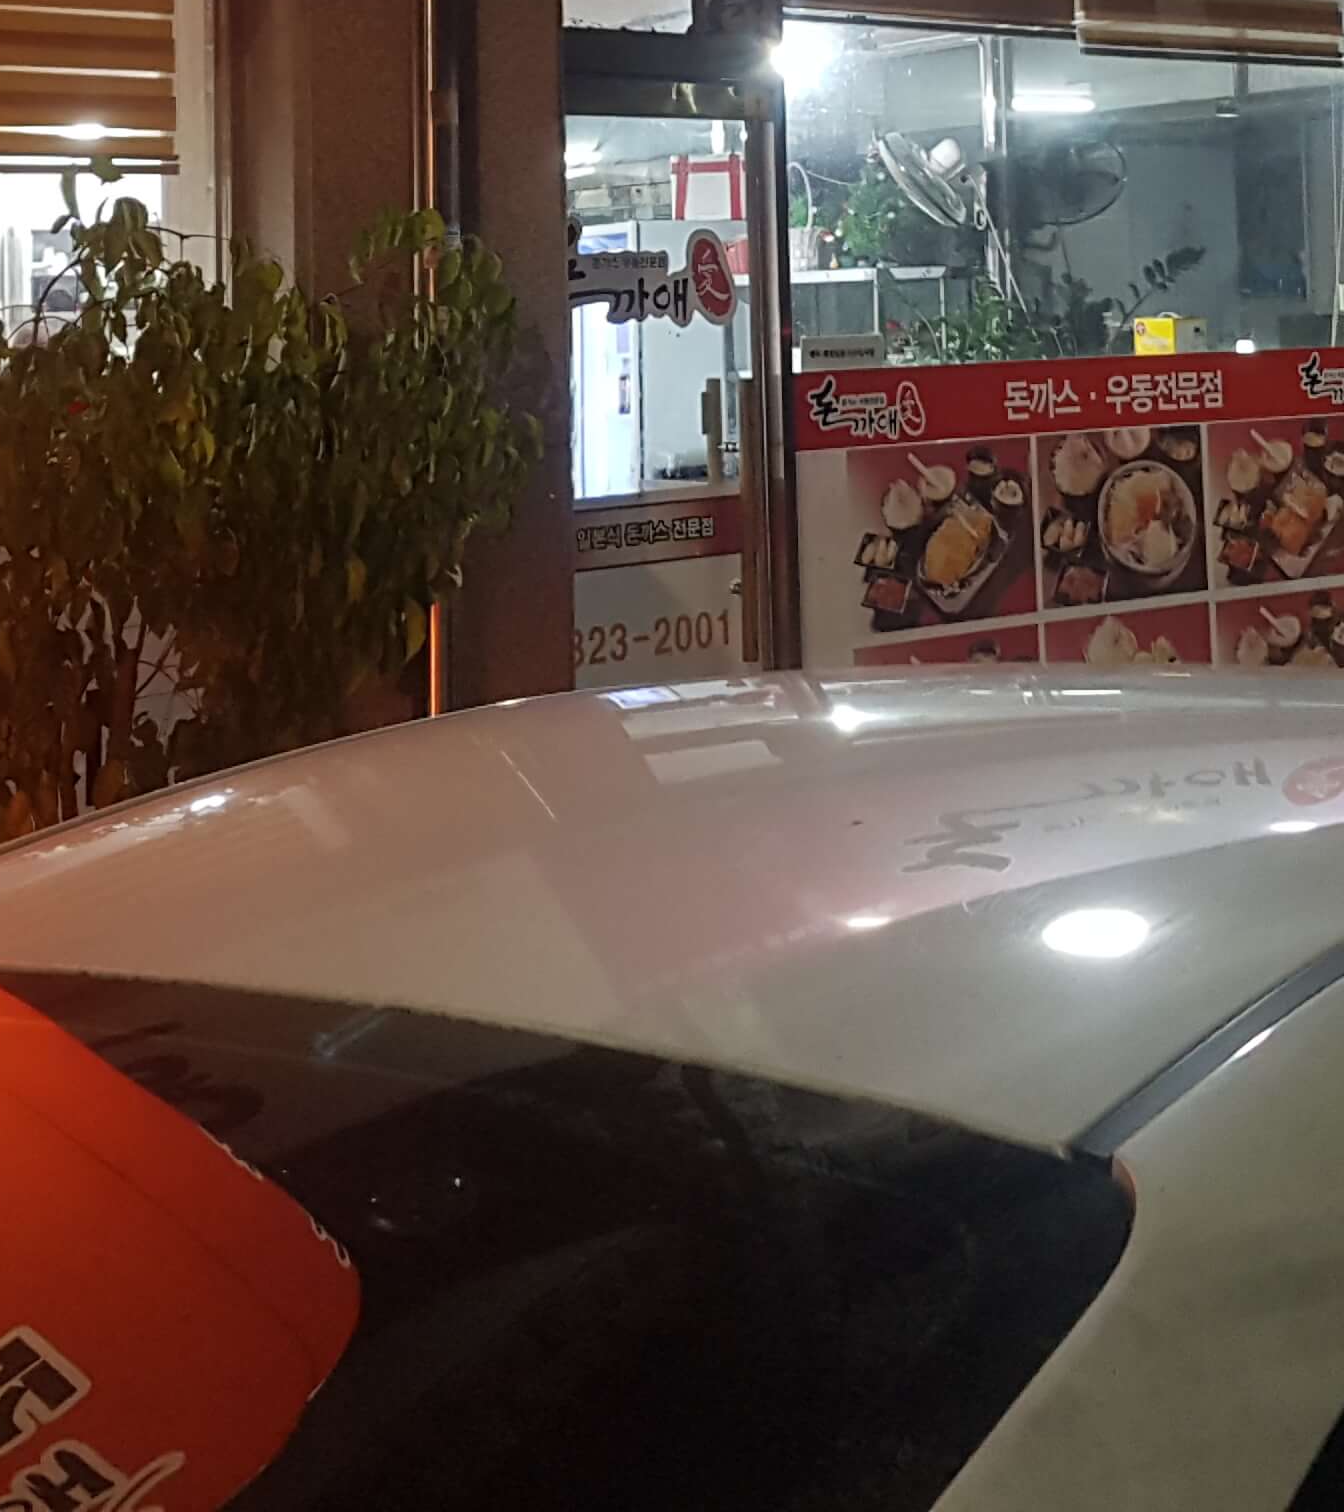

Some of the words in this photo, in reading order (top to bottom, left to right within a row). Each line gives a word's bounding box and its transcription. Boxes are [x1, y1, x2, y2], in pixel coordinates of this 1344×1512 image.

[1004, 378, 1081, 420] 돈까스
[1106, 370, 1223, 414] 우동전문점
[577, 524, 622, 552] 일본식
[624, 520, 670, 546] 돈까스
[672, 516, 714, 540] 전문점
